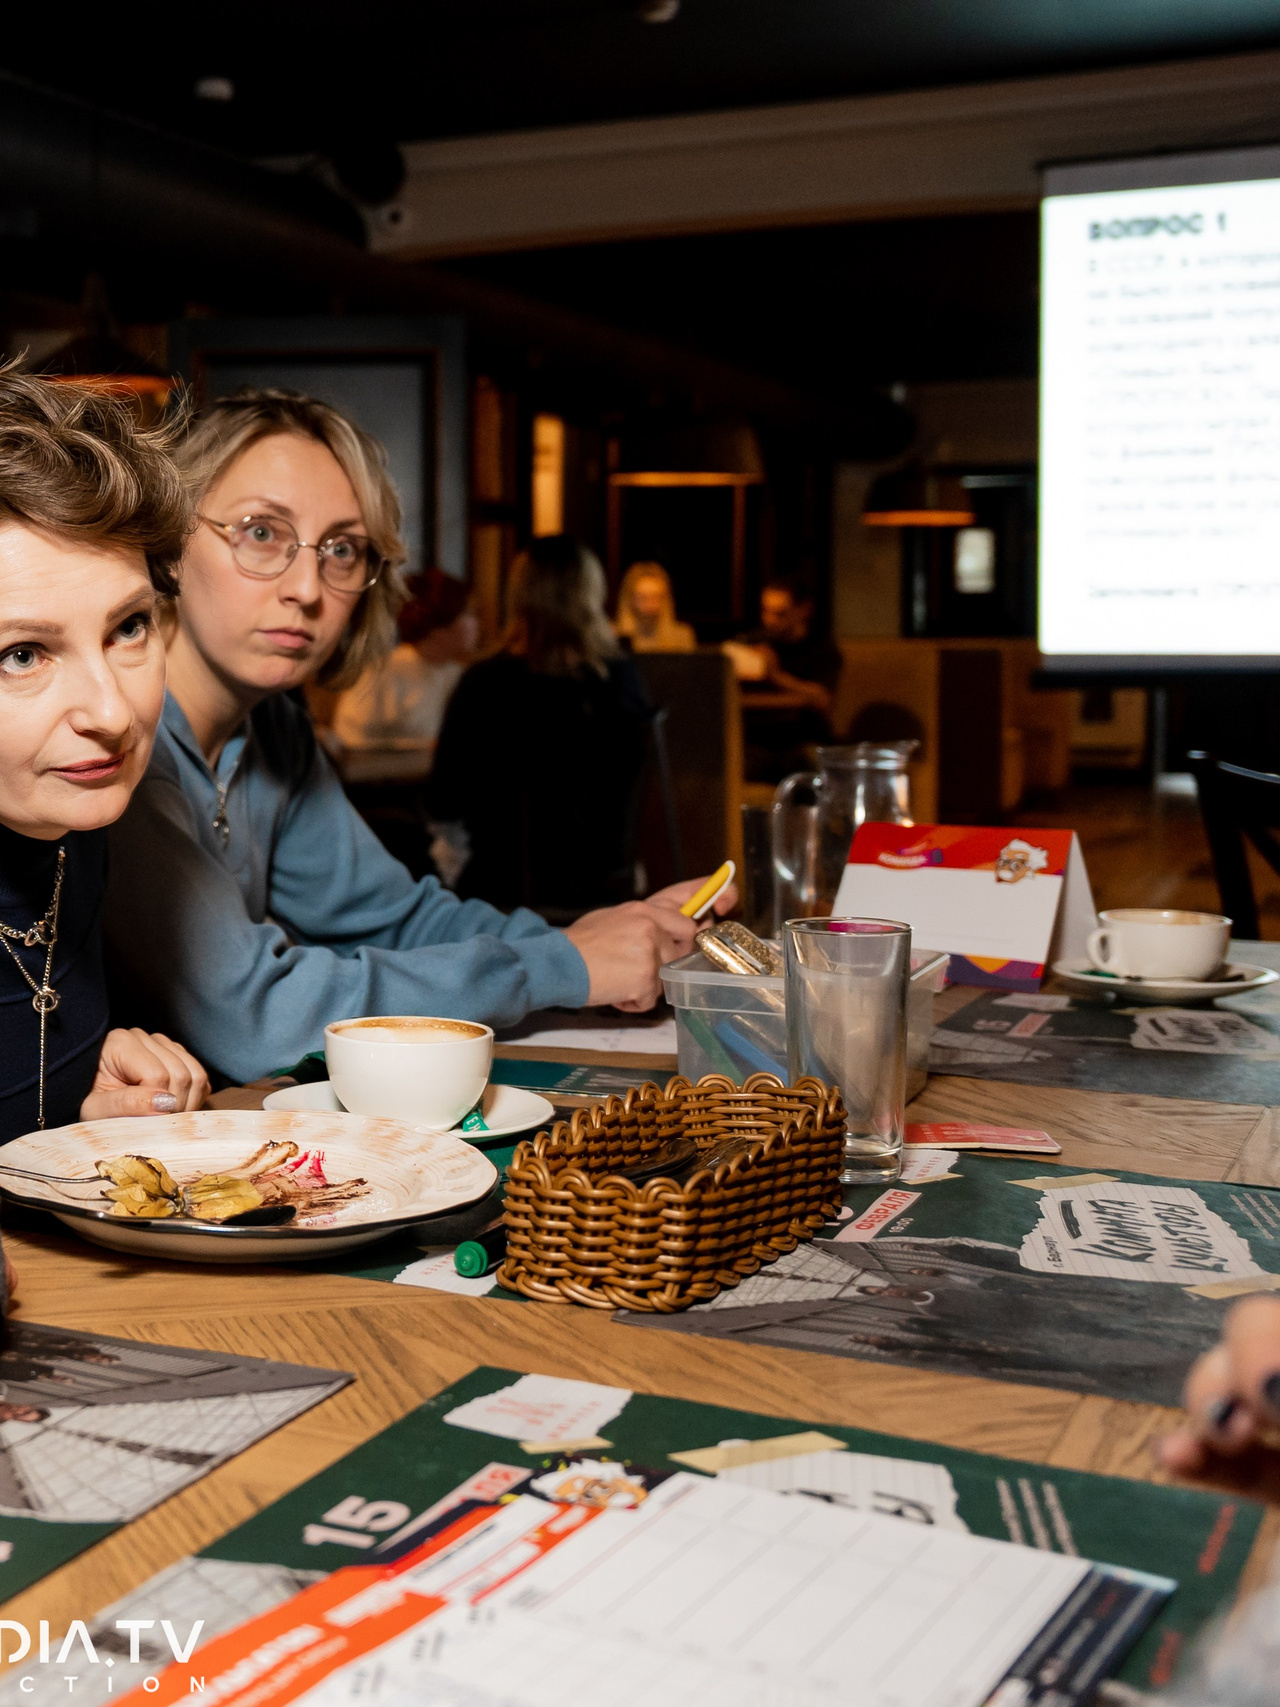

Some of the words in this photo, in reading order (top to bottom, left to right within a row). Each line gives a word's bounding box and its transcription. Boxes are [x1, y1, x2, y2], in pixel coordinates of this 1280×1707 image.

[1089, 214, 1204, 241] ВОПРОС
[855, 1191, 914, 1230] ФЕВРАЛЯ
[1070, 1198, 1157, 1264] КОМНАТА
[1042, 1235, 1063, 1263] Барнаул
[1149, 1199, 1231, 1274] КУЛЬТУРЫ
[302, 1494, 412, 1550] 15
